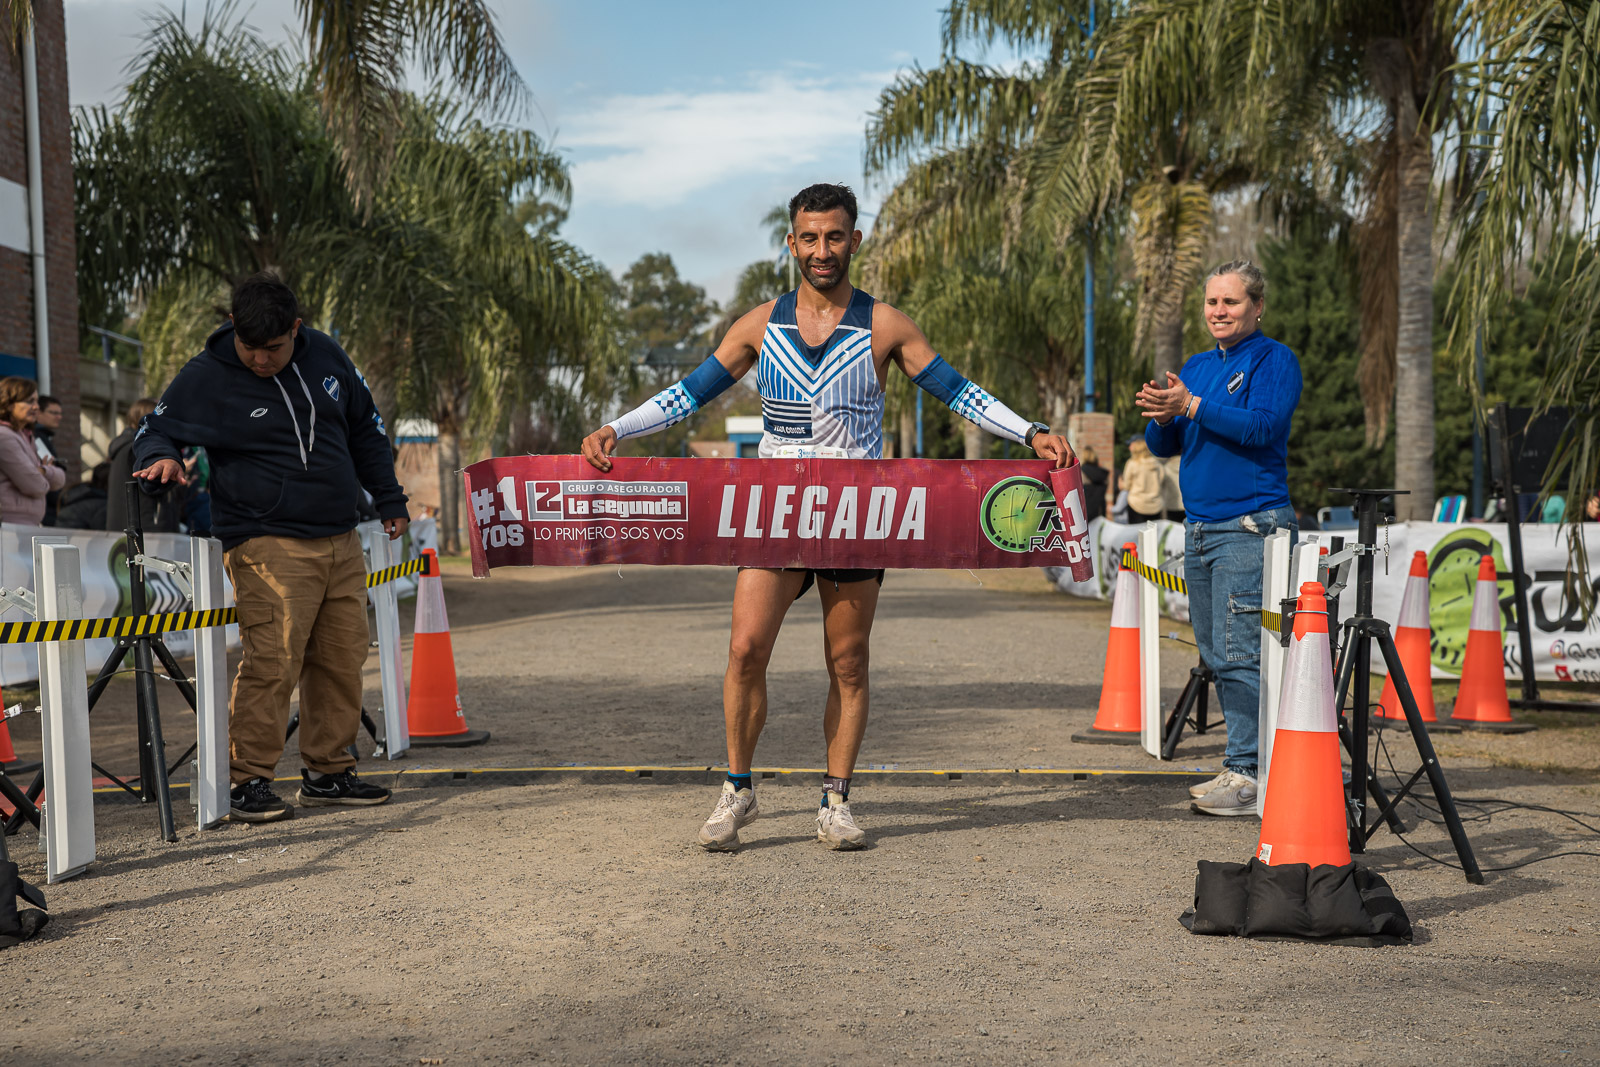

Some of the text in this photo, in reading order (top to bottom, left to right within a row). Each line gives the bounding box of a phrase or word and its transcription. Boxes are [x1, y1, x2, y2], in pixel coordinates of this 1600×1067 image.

[568, 484, 681, 494] GRUPO ASEGURADOR
[471, 476, 522, 526] #1
[592, 498, 682, 518] segunda
[717, 484, 927, 540] LLEGADA
[534, 526, 684, 541] LO PRIMERO SOS VOS
